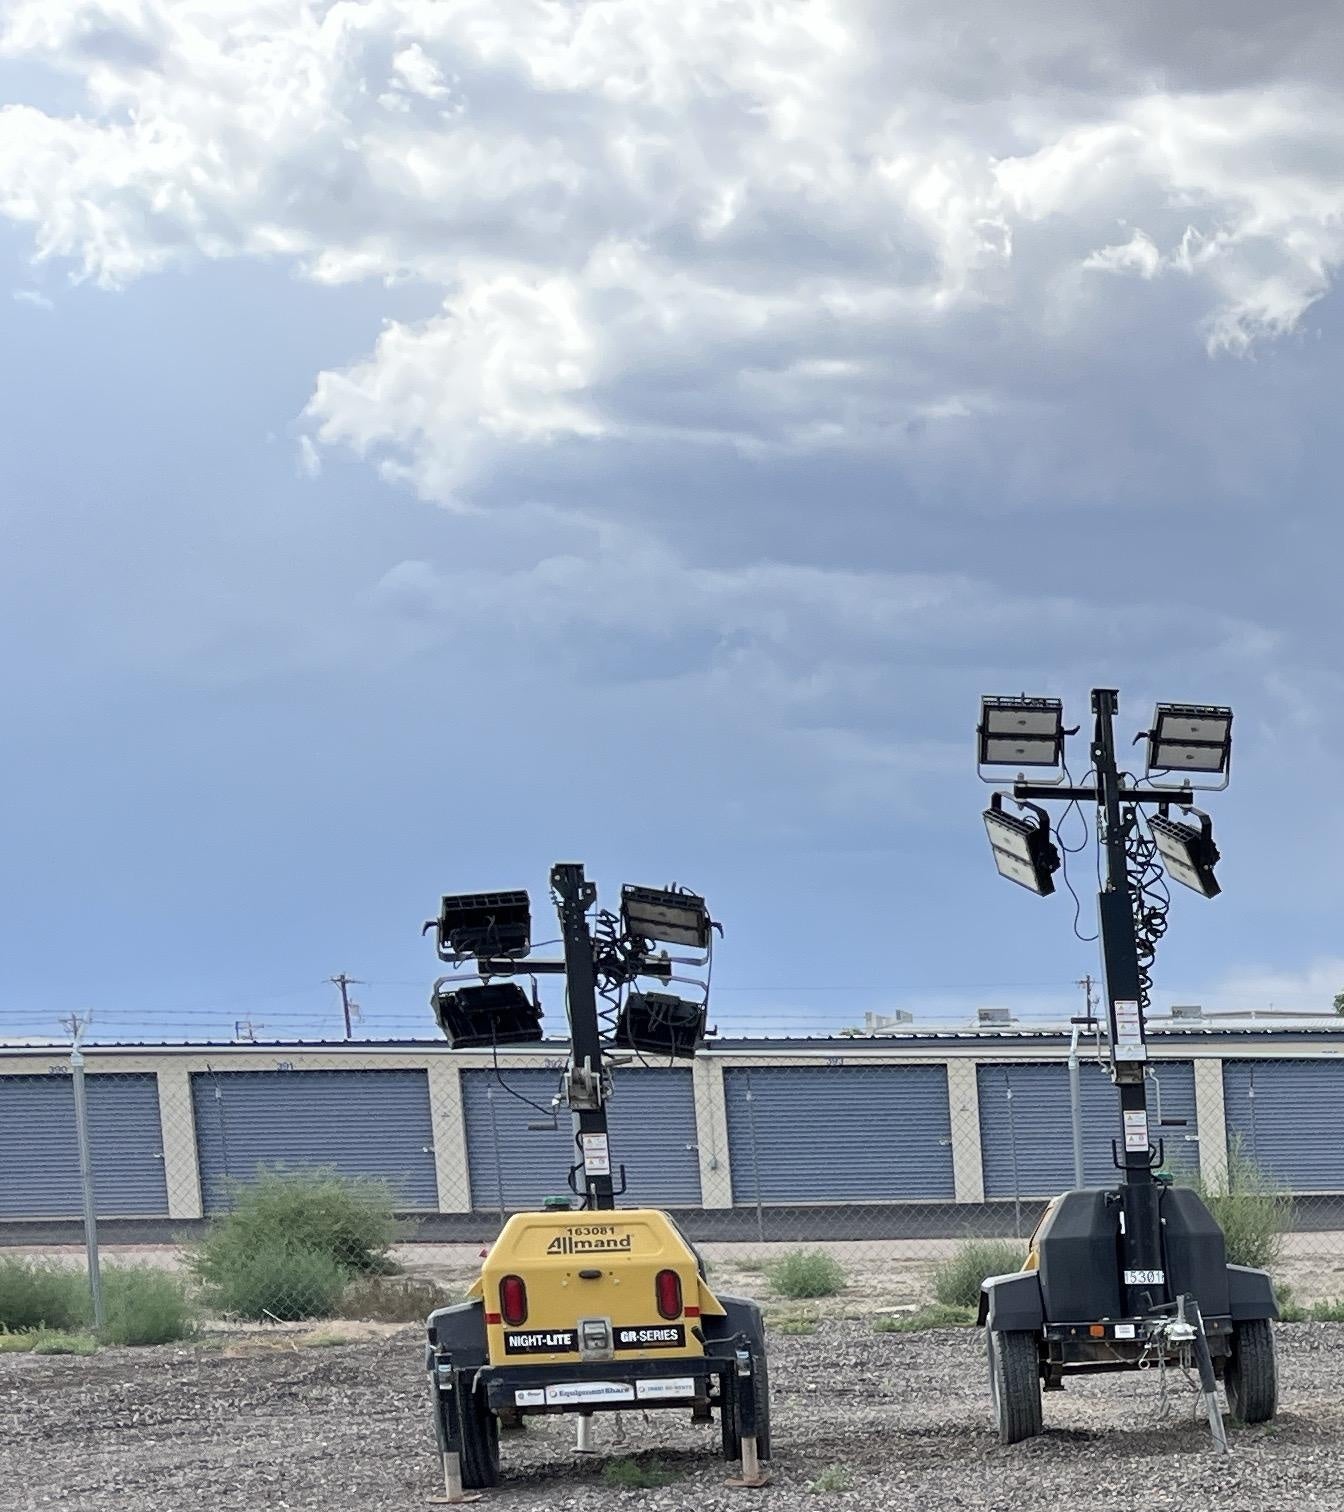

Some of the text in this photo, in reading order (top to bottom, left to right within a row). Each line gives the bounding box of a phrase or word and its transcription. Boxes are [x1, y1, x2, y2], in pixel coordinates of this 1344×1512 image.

[566, 1226, 616, 1236] 163081
[546, 1234, 632, 1255] Allmand
[509, 1333, 573, 1347] NIGHT-LITE
[620, 1328, 679, 1343] GR-SERIES
